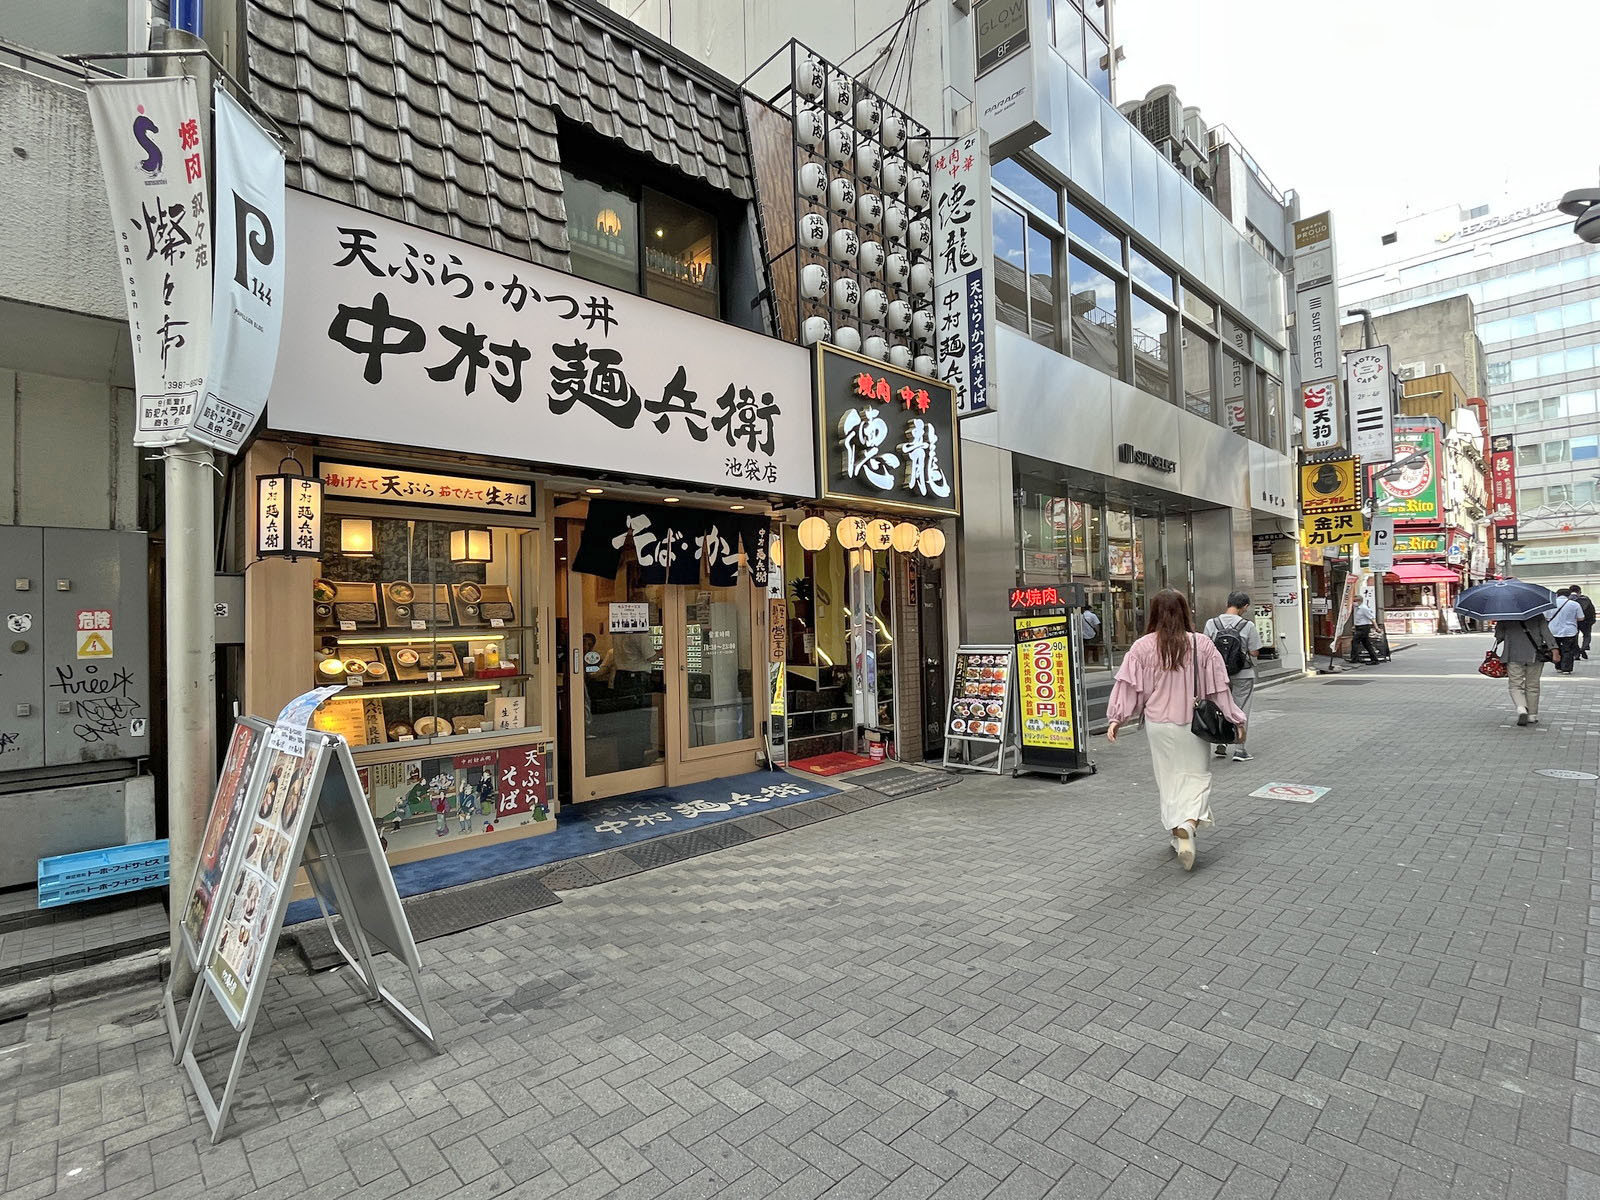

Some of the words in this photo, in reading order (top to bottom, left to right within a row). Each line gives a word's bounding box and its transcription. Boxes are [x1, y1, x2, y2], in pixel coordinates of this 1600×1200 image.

[997, 40, 1011, 58] 8F
[178, 118, 203, 184] 焼肉
[964, 138, 976, 150] 2F
[1296, 225, 1327, 240] PROUD
[121, 232, 132, 265] san
[129, 277, 138, 309] san
[332, 225, 620, 340] 天ぷら・かつ丼
[251, 276, 272, 307] 144
[1310, 311, 1321, 331] SUIT
[1312, 332, 1324, 369] SELECT
[1353, 355, 1381, 368] MOTTO
[1356, 374, 1379, 384] CAFE
[857, 372, 892, 404] 焼肉
[900, 385, 931, 414] 中華
[1312, 408, 1332, 440] 天狗
[725, 456, 779, 485] 池袋店
[324, 473, 435, 498] 揚げたて天ぷら
[438, 484, 529, 507] 茹でたて生そば
[1406, 498, 1434, 512] Rico
[878, 522, 891, 545] 中華
[1314, 514, 1354, 531] 金沢
[1308, 531, 1362, 545] カレー
[1408, 536, 1438, 550] Rico
[78, 611, 111, 630] 危険
[1033, 642, 1057, 717] 2000円
[500, 765, 520, 813] そば
[522, 749, 541, 811] 天ぷら
